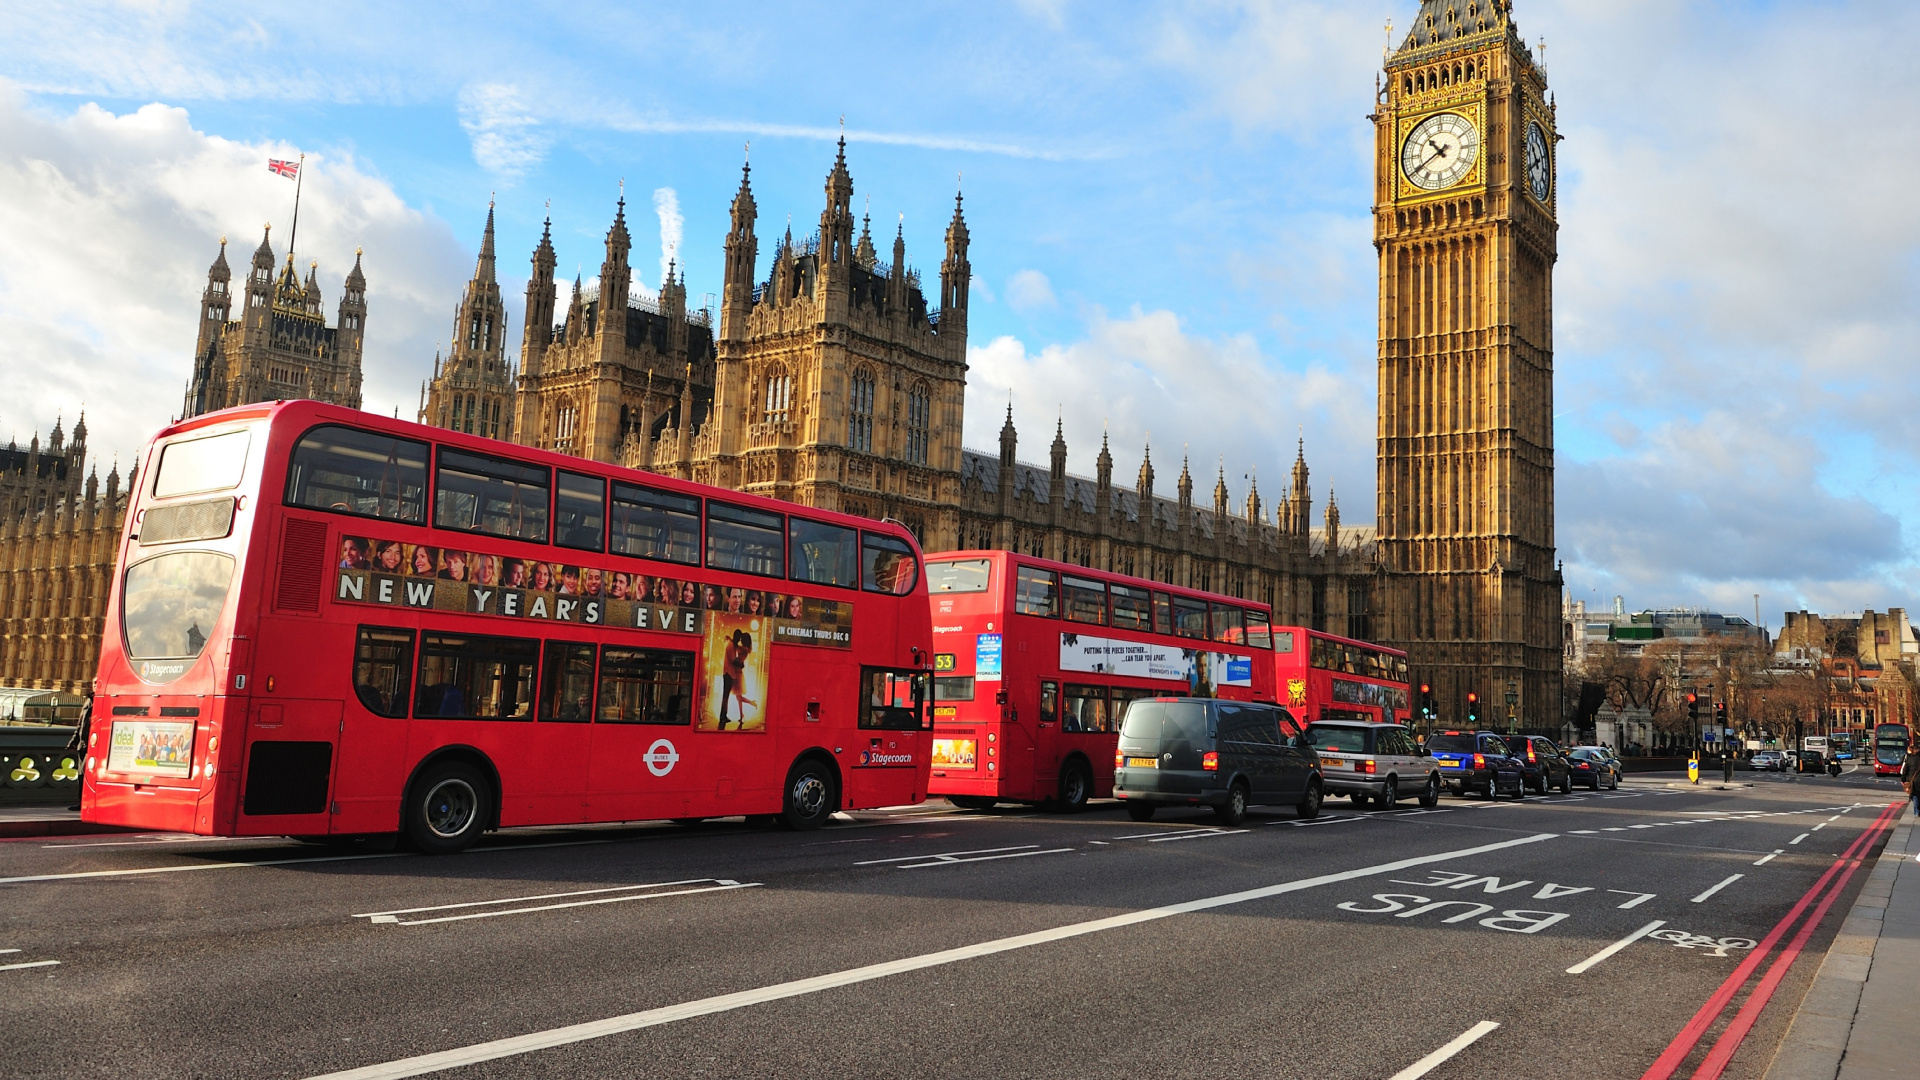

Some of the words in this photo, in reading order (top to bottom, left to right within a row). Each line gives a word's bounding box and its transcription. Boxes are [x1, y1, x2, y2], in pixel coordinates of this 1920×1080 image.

[339, 575, 434, 605] NEW
[474, 589, 599, 624] YEAR'S
[637, 608, 695, 632] EVE
[778, 626, 785, 634] IN
[787, 627, 812, 638] CINEMAS
[814, 630, 831, 639] THURS
[833, 632, 843, 640] DEC
[844, 633, 849, 641] 8
[933, 626, 962, 634] Stagecoach
[1084, 647, 1102, 655] PUTTING
[936, 655, 951, 668] 53
[149, 663, 184, 676] Stagecoach
[114, 728, 134, 745] ideal
[871, 753, 912, 765] Stagecoach
[1389, 870, 1657, 909] LANE
[1337, 893, 1570, 934] BUS
